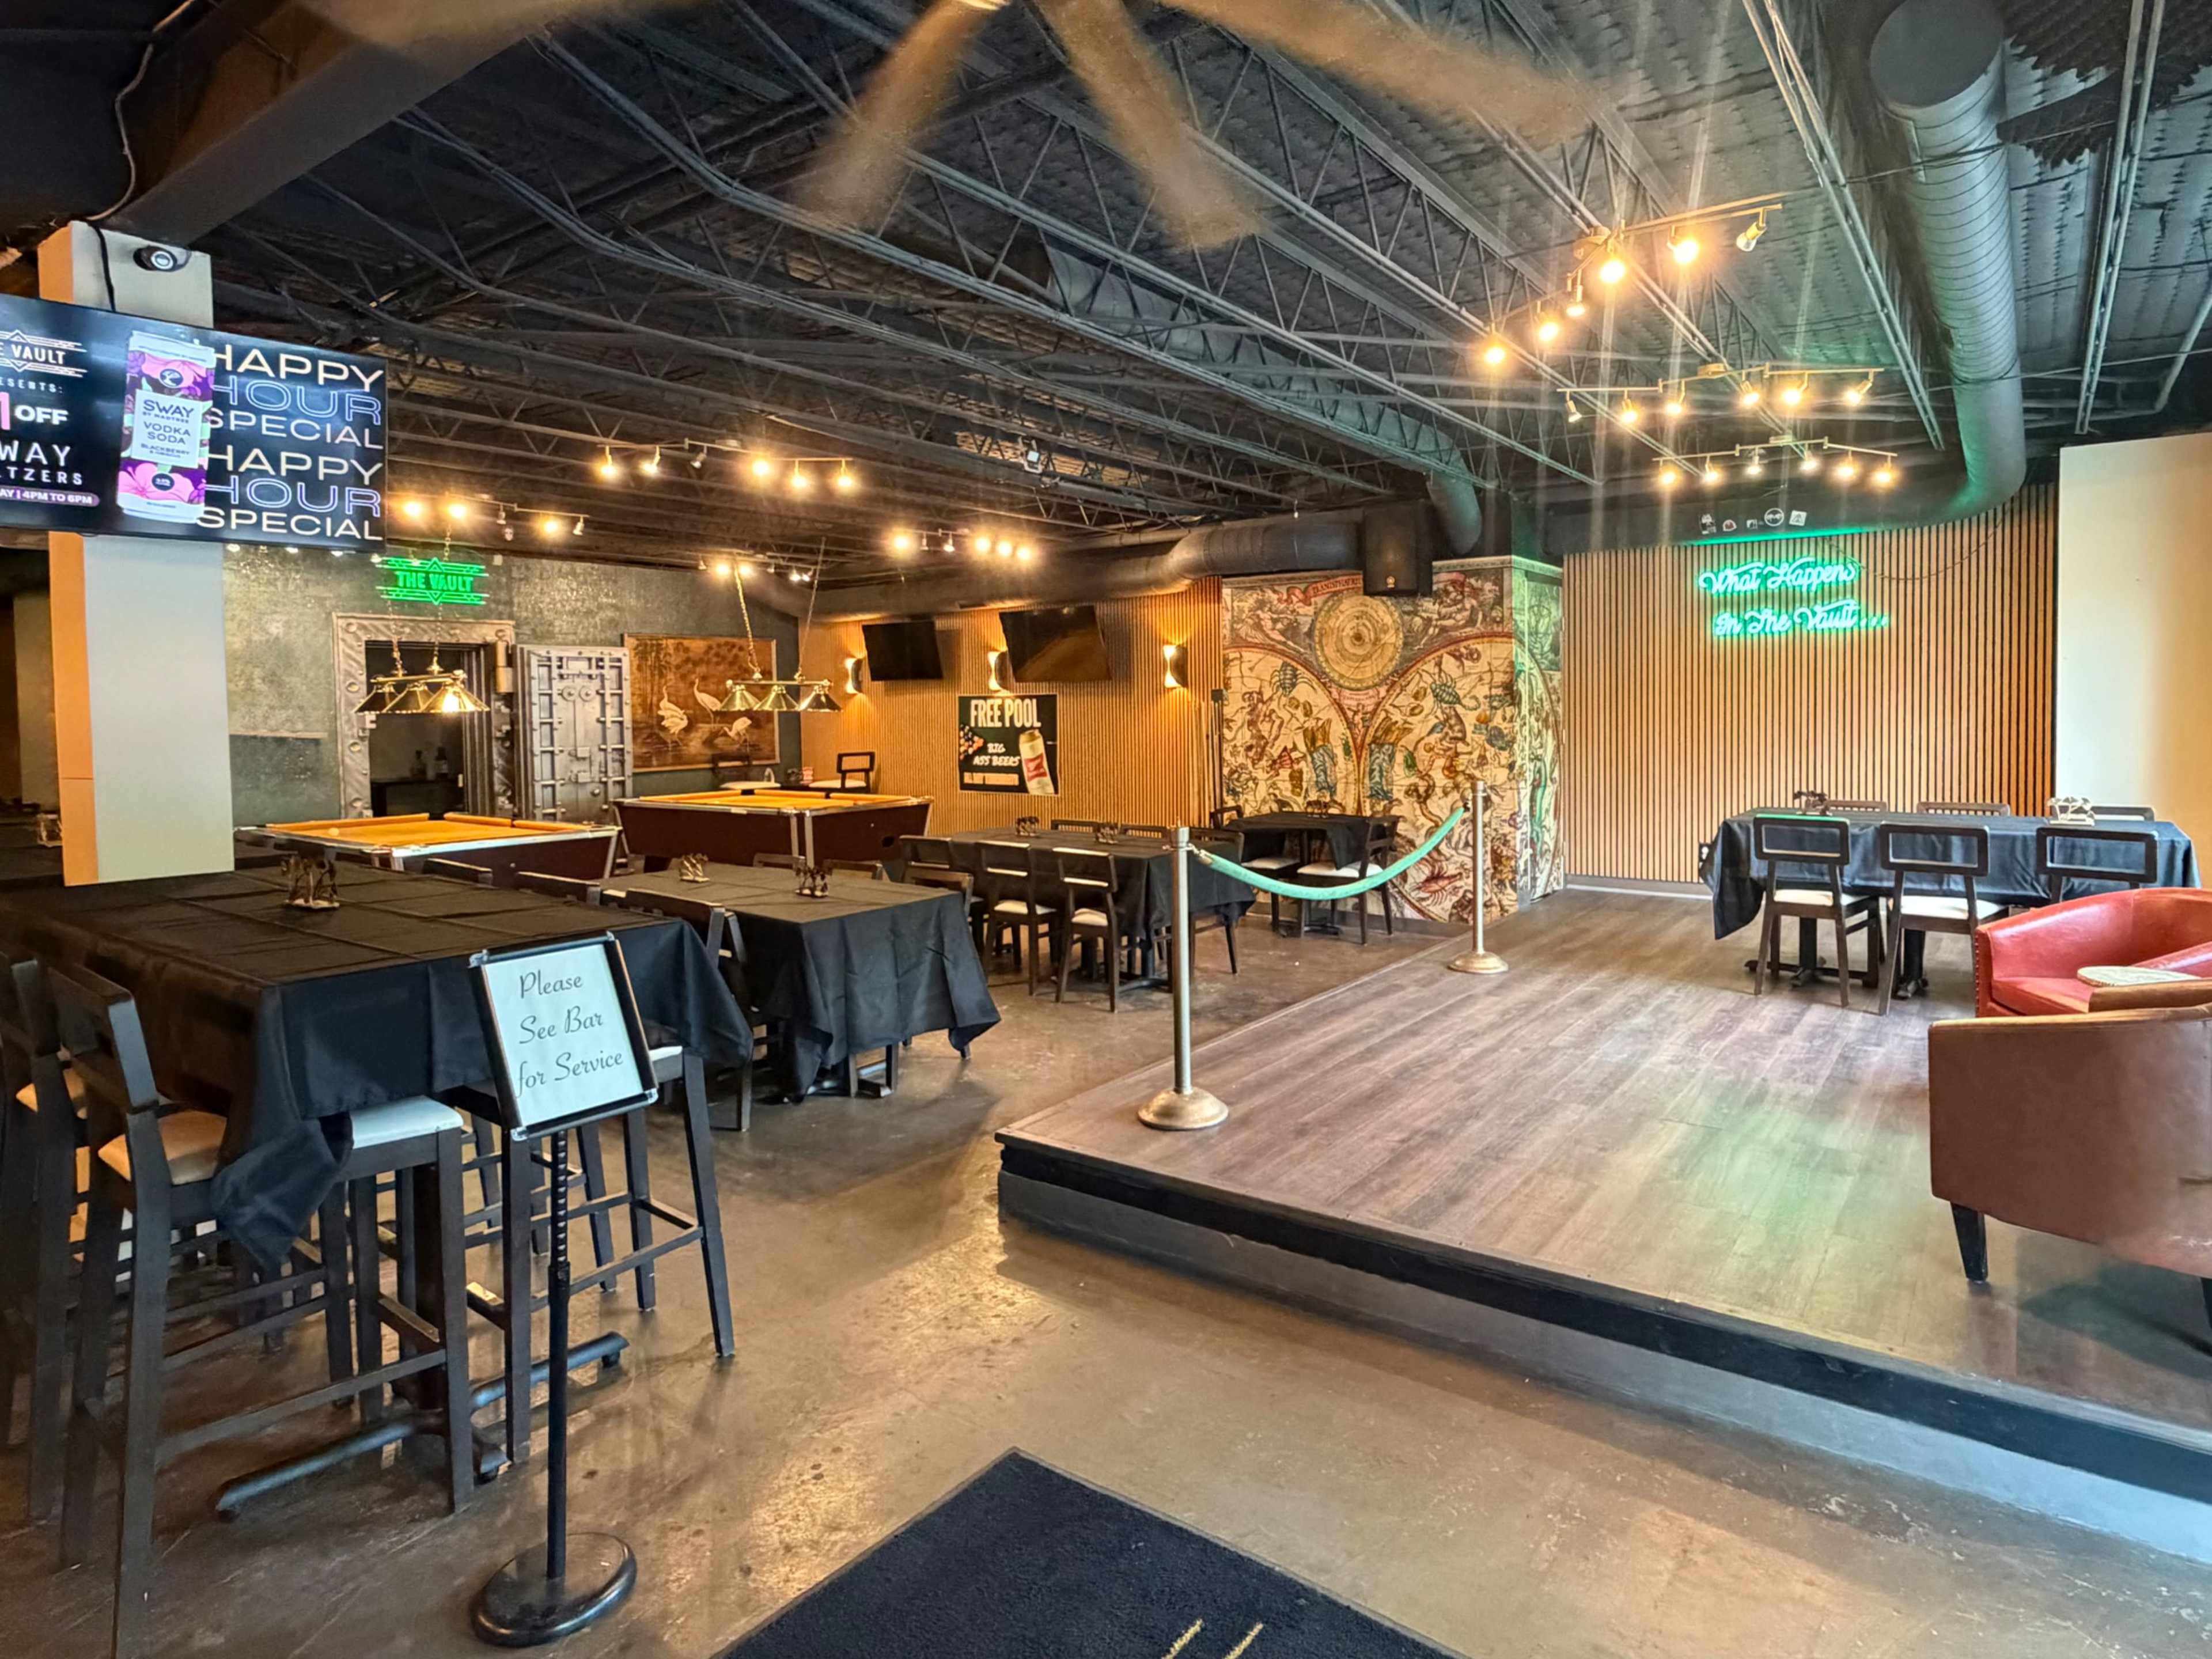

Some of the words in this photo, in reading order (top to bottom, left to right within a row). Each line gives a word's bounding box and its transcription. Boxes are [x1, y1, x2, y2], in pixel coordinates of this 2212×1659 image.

[12, 344, 66, 365] VAULT
[215, 344, 384, 392] HAPPY
[143, 399, 194, 418] SWAY
[212, 375, 381, 425] HOUR
[14, 404, 69, 425] OFF
[143, 421, 191, 436] VODKA
[147, 431, 186, 445] SODA
[0, 466, 82, 485] TZERS
[209, 445, 383, 485] HAPPY
[50, 492, 65, 502] TO
[206, 475, 381, 517] HOUR
[196, 507, 383, 540] SPECIAL
[395, 571, 425, 588] THE
[429, 574, 474, 592] VAULT
[1698, 562, 1764, 594] What
[1763, 557, 1856, 592] Happens
[1715, 613, 1742, 635] In
[1745, 608, 1791, 633] The
[970, 699, 1002, 728] FREE
[1004, 698, 1041, 728] POOL
[972, 755, 991, 766] ASS
[991, 755, 1021, 767] BEERS
[987, 743, 1006, 753] BIG
[520, 969, 584, 999] Please
[519, 1015, 557, 1044] See
[565, 1005, 604, 1034] Bar
[516, 1060, 546, 1098] for
[554, 1050, 624, 1082] Service
